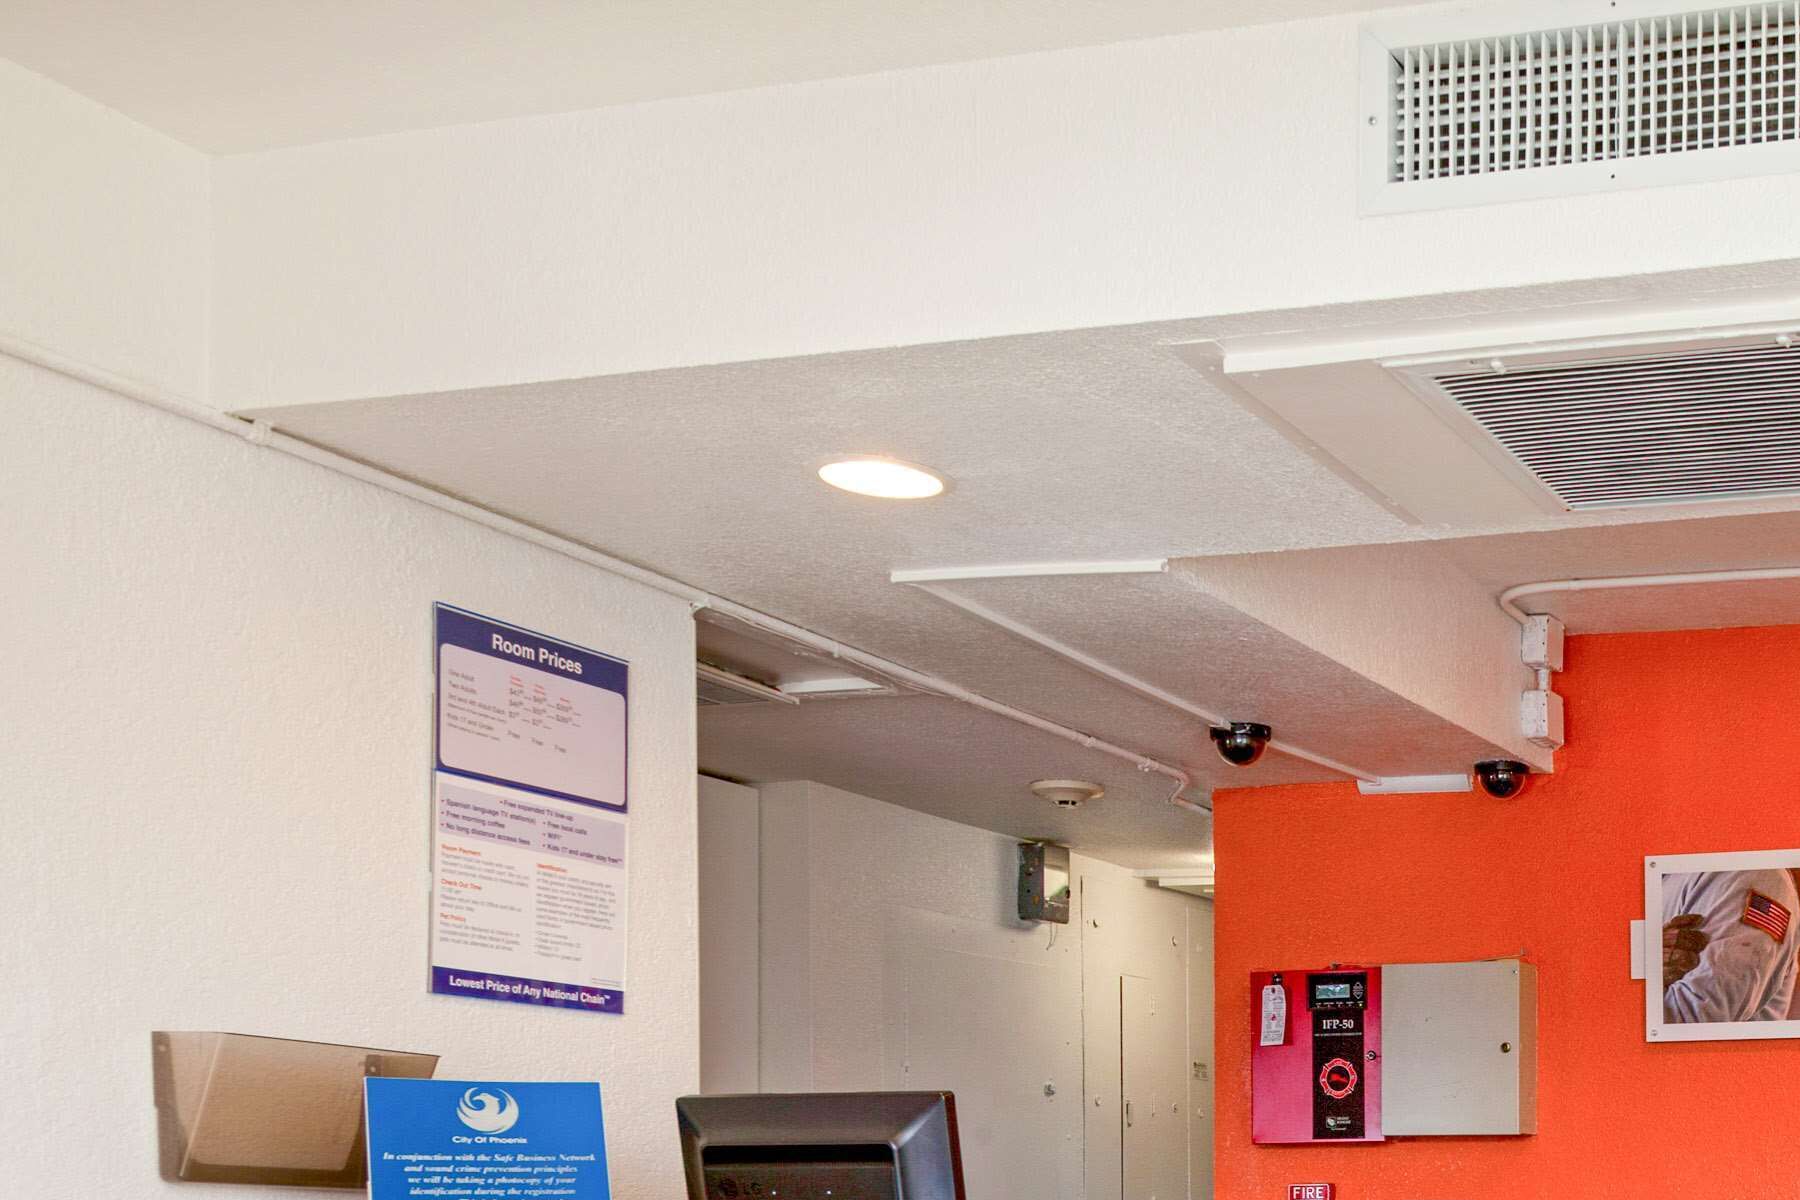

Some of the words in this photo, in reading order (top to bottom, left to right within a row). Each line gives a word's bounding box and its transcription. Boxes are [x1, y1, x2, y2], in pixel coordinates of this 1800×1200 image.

[492, 633, 535, 660] Room
[539, 648, 583, 675] Prices
[472, 805, 499, 818] language
[449, 975, 484, 990] Lowest
[486, 979, 510, 993] Price
[512, 983, 522, 994] of
[522, 984, 541, 999] Any
[543, 987, 579, 1002] National
[1322, 1019, 1354, 1030] IFP-50
[452, 1135, 473, 1144] City
[489, 1136, 528, 1144] Phoenix
[383, 1151, 395, 1160] In
[396, 1153, 453, 1162] conjunction
[455, 1153, 475, 1161] with
[476, 1153, 492, 1161] the
[493, 1153, 514, 1163] Safe
[516, 1153, 557, 1161] Business
[559, 1153, 595, 1161] Network
[403, 1164, 423, 1172] and
[424, 1164, 455, 1172] sound
[483, 1165, 533, 1174] prevention
[533, 1165, 578, 1174] principles
[423, 1176, 441, 1184] will
[442, 1176, 455, 1184] be
[455, 1176, 486, 1185] taking
[494, 1176, 542, 1185] photocopy
[543, 1176, 555, 1186] of
[409, 1187, 472, 1196] identification
[474, 1187, 506, 1196] during
[506, 1187, 522, 1195] the
[523, 1188, 577, 1197] registration
[743, 1182, 762, 1195] LG
[1293, 1186, 1324, 1199] FIRE
